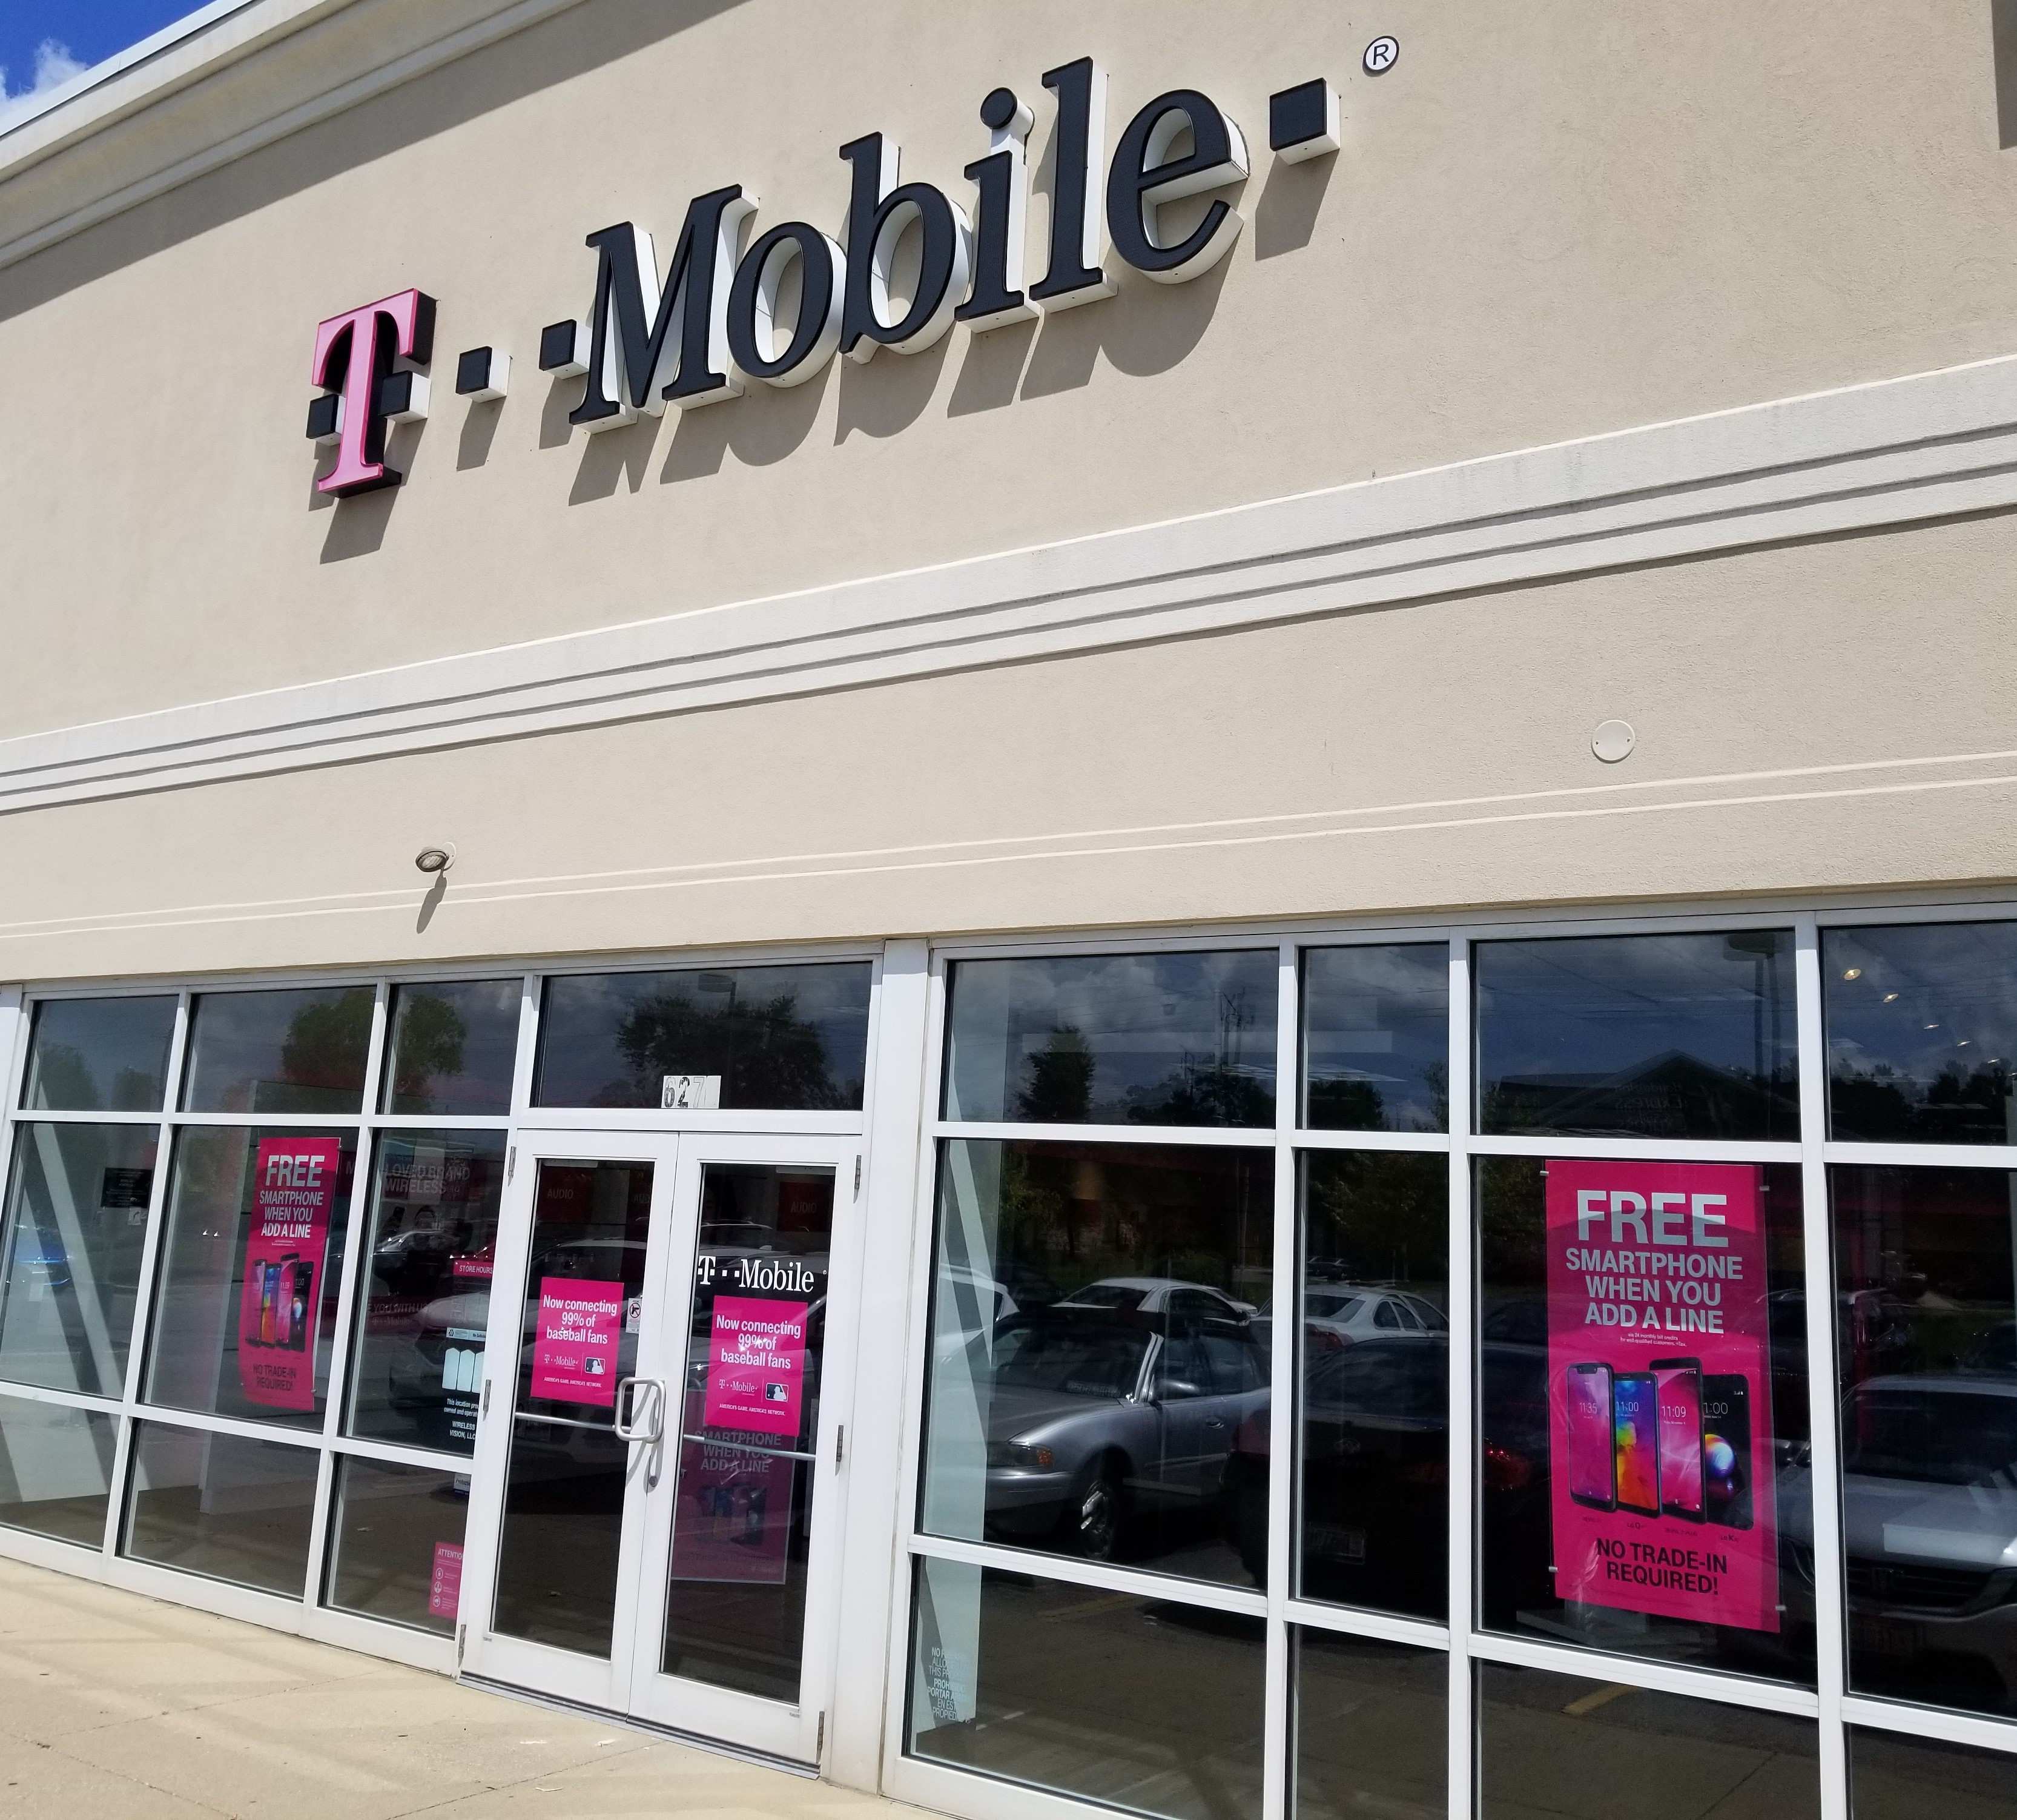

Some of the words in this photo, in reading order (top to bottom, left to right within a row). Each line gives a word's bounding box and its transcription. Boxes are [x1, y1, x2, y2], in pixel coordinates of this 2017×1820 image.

[265, 1155, 325, 1187] FREE
[386, 1178, 446, 1194] WIRELESS
[547, 1188, 573, 1199] AUDIO
[259, 1190, 324, 1206] SMARTPHONE
[265, 1206, 291, 1221] WHEN
[293, 1208, 313, 1222] YOU
[790, 1201, 817, 1213] AUDIO
[1577, 1190, 1729, 1247] FREE
[261, 1223, 281, 1237] ADD
[281, 1223, 289, 1237] A
[289, 1223, 311, 1238] LINE
[460, 1265, 475, 1273] STORE
[476, 1266, 493, 1274] HOURS
[1566, 1248, 1743, 1280] SMARTPHONE
[1585, 1275, 1660, 1302] WHEN
[1666, 1280, 1721, 1306] YOU
[543, 1294, 564, 1308] Now
[565, 1300, 617, 1317] connecting
[561, 1312, 584, 1326] 99%
[586, 1314, 596, 1327] of
[1585, 1302, 1637, 1327] ADD
[1642, 1306, 1661, 1329] A
[1666, 1308, 1725, 1334] LINE
[716, 1315, 739, 1330] Now
[741, 1320, 801, 1339] connecting
[546, 1326, 586, 1342] baseball
[587, 1329, 608, 1344] fans
[738, 1333, 764, 1349] 99%
[766, 1336, 777, 1350] of
[721, 1348, 766, 1366] baseball
[768, 1352, 791, 1369] fans
[1579, 1402, 1597, 1414] 11:35
[1616, 1401, 1639, 1412] 11:00
[1662, 1405, 1686, 1418] 11:09
[452, 1420, 475, 1430] WIRELESS
[450, 1429, 466, 1439] VISION,
[695, 1429, 781, 1446] SMARTPHONE
[703, 1444, 741, 1458] WHEN
[701, 1458, 727, 1471] ADD
[742, 1460, 770, 1473] LINE
[1596, 1538, 1626, 1559] NO
[1629, 1543, 1728, 1574] TRADE-IN
[1606, 1561, 1718, 1595] REQUIRED!
[932, 1647, 941, 1656] NO
[929, 1665, 941, 1676] THIS
[928, 1686, 950, 1699] PORTAR
[937, 1698, 945, 1709] EN
[933, 1707, 957, 1721] PROPIED
